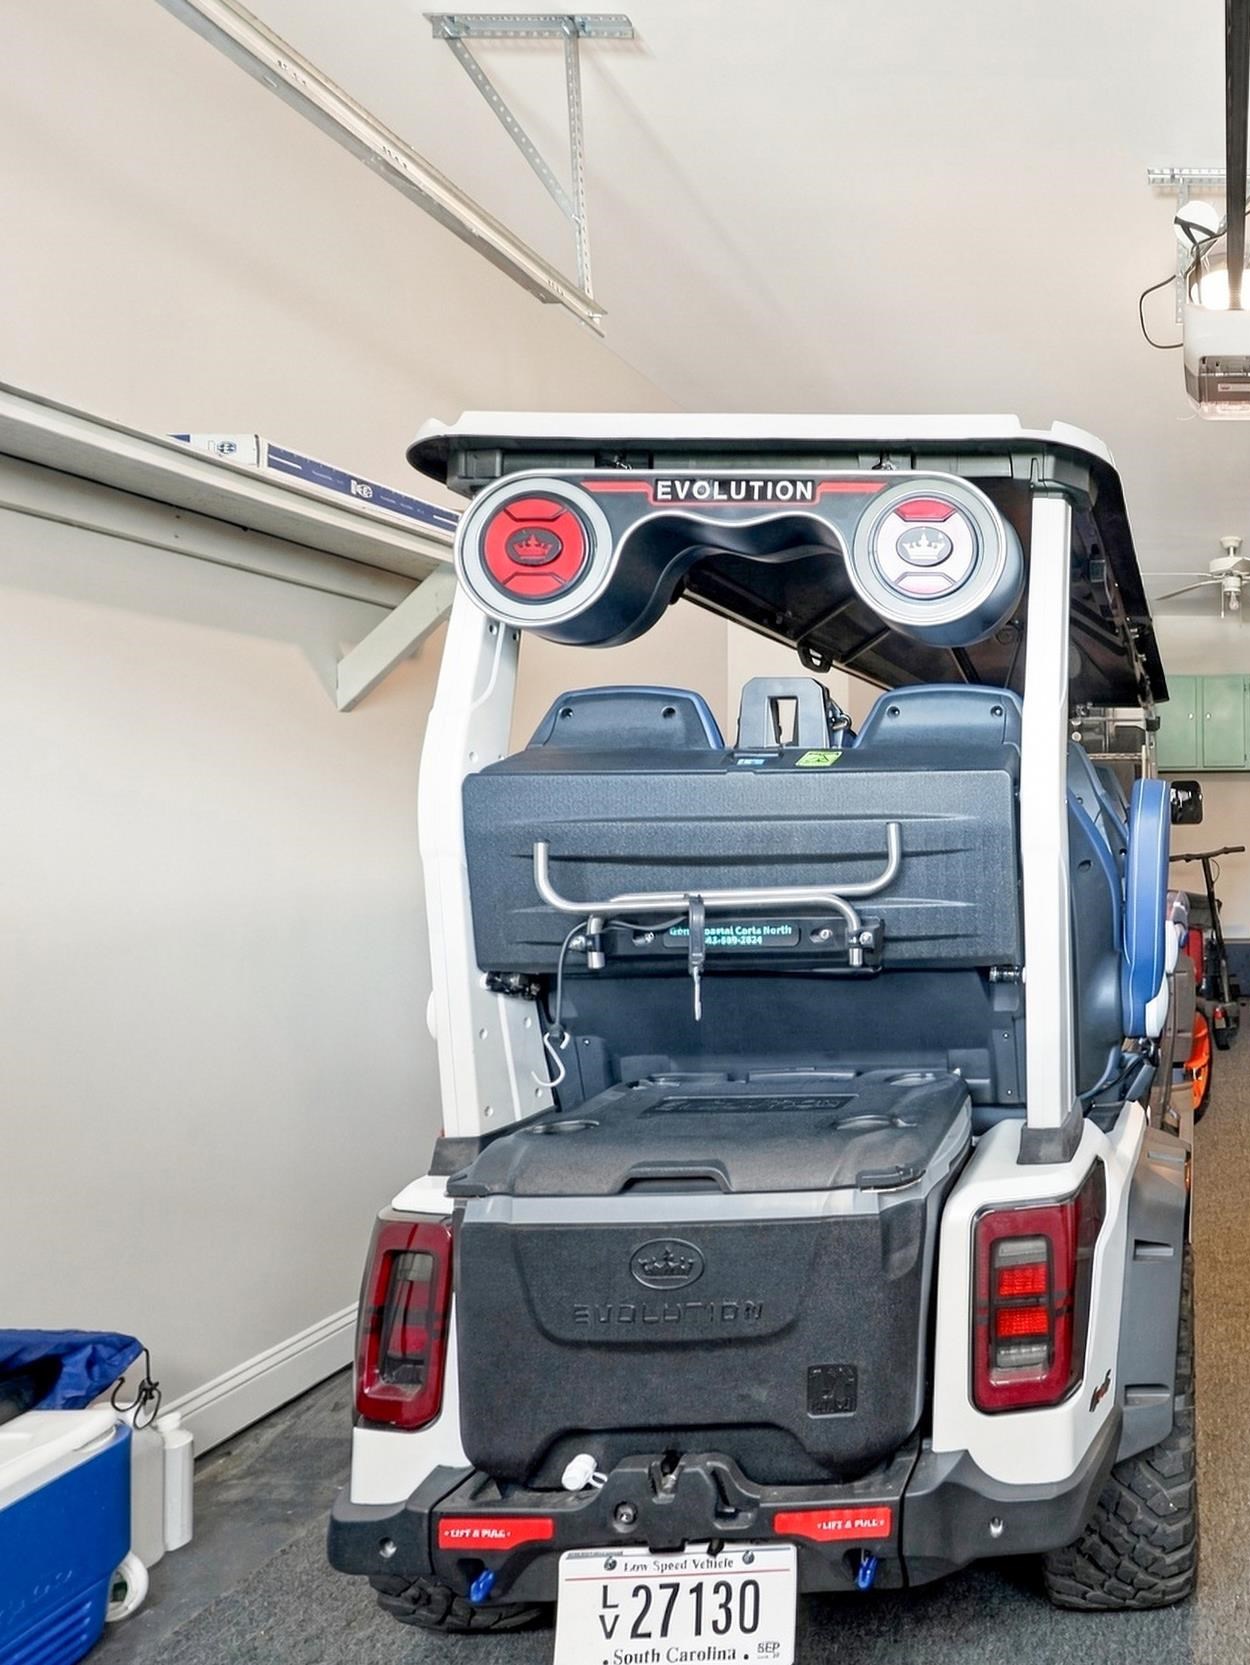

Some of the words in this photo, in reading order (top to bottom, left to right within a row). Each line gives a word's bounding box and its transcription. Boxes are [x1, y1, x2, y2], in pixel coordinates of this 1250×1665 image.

[656, 480, 813, 501] EVOLUTION
[704, 926, 733, 935] oastal
[763, 925, 792, 935] North
[574, 1301, 764, 1324] EVOLUTION
[624, 1561, 649, 1572] Low
[653, 1560, 687, 1574] Speed
[692, 1556, 734, 1570] Vehicle
[630, 1579, 760, 1640] 27130
[612, 1647, 661, 1665] South
[666, 1646, 737, 1664] Carolina
[757, 1640, 780, 1653] SEP
